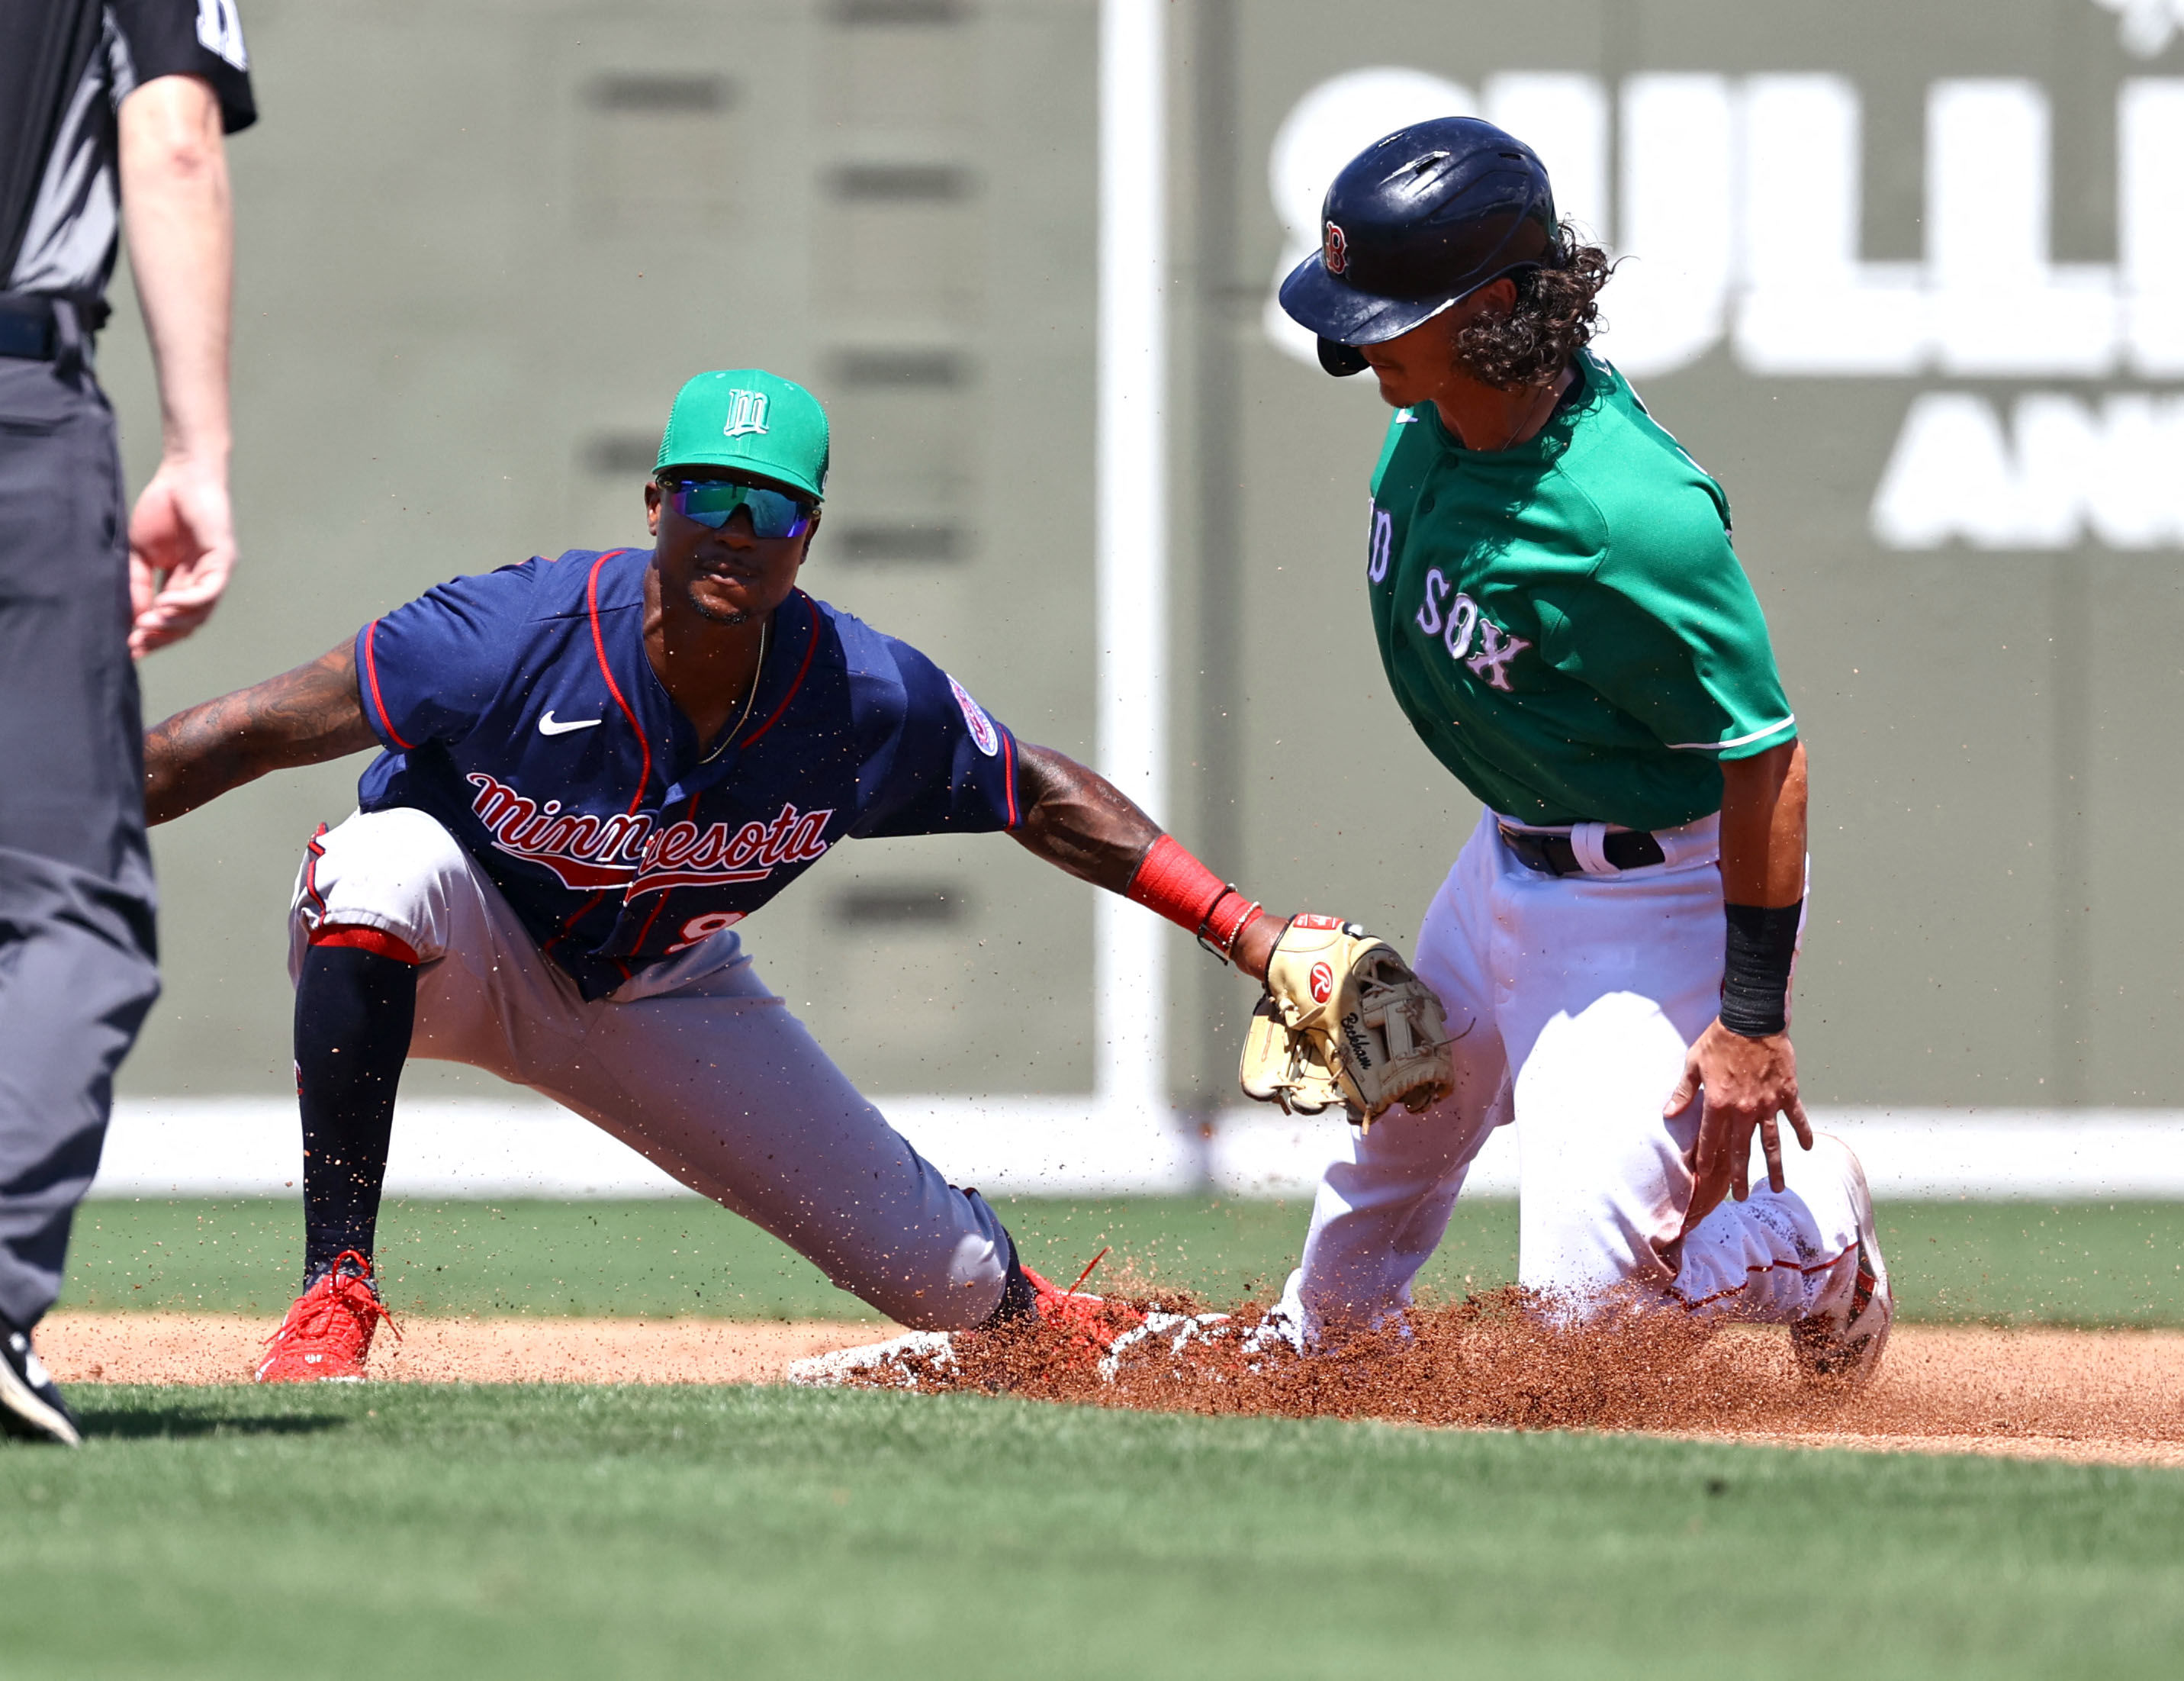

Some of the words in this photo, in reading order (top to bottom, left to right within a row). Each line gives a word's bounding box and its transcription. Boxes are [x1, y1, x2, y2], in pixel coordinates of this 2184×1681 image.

[1326, 221, 1349, 274] B
[1415, 565, 1533, 692] SOX
[466, 772, 835, 876] Minnesota
[1340, 1012, 1372, 1070] Beckham
